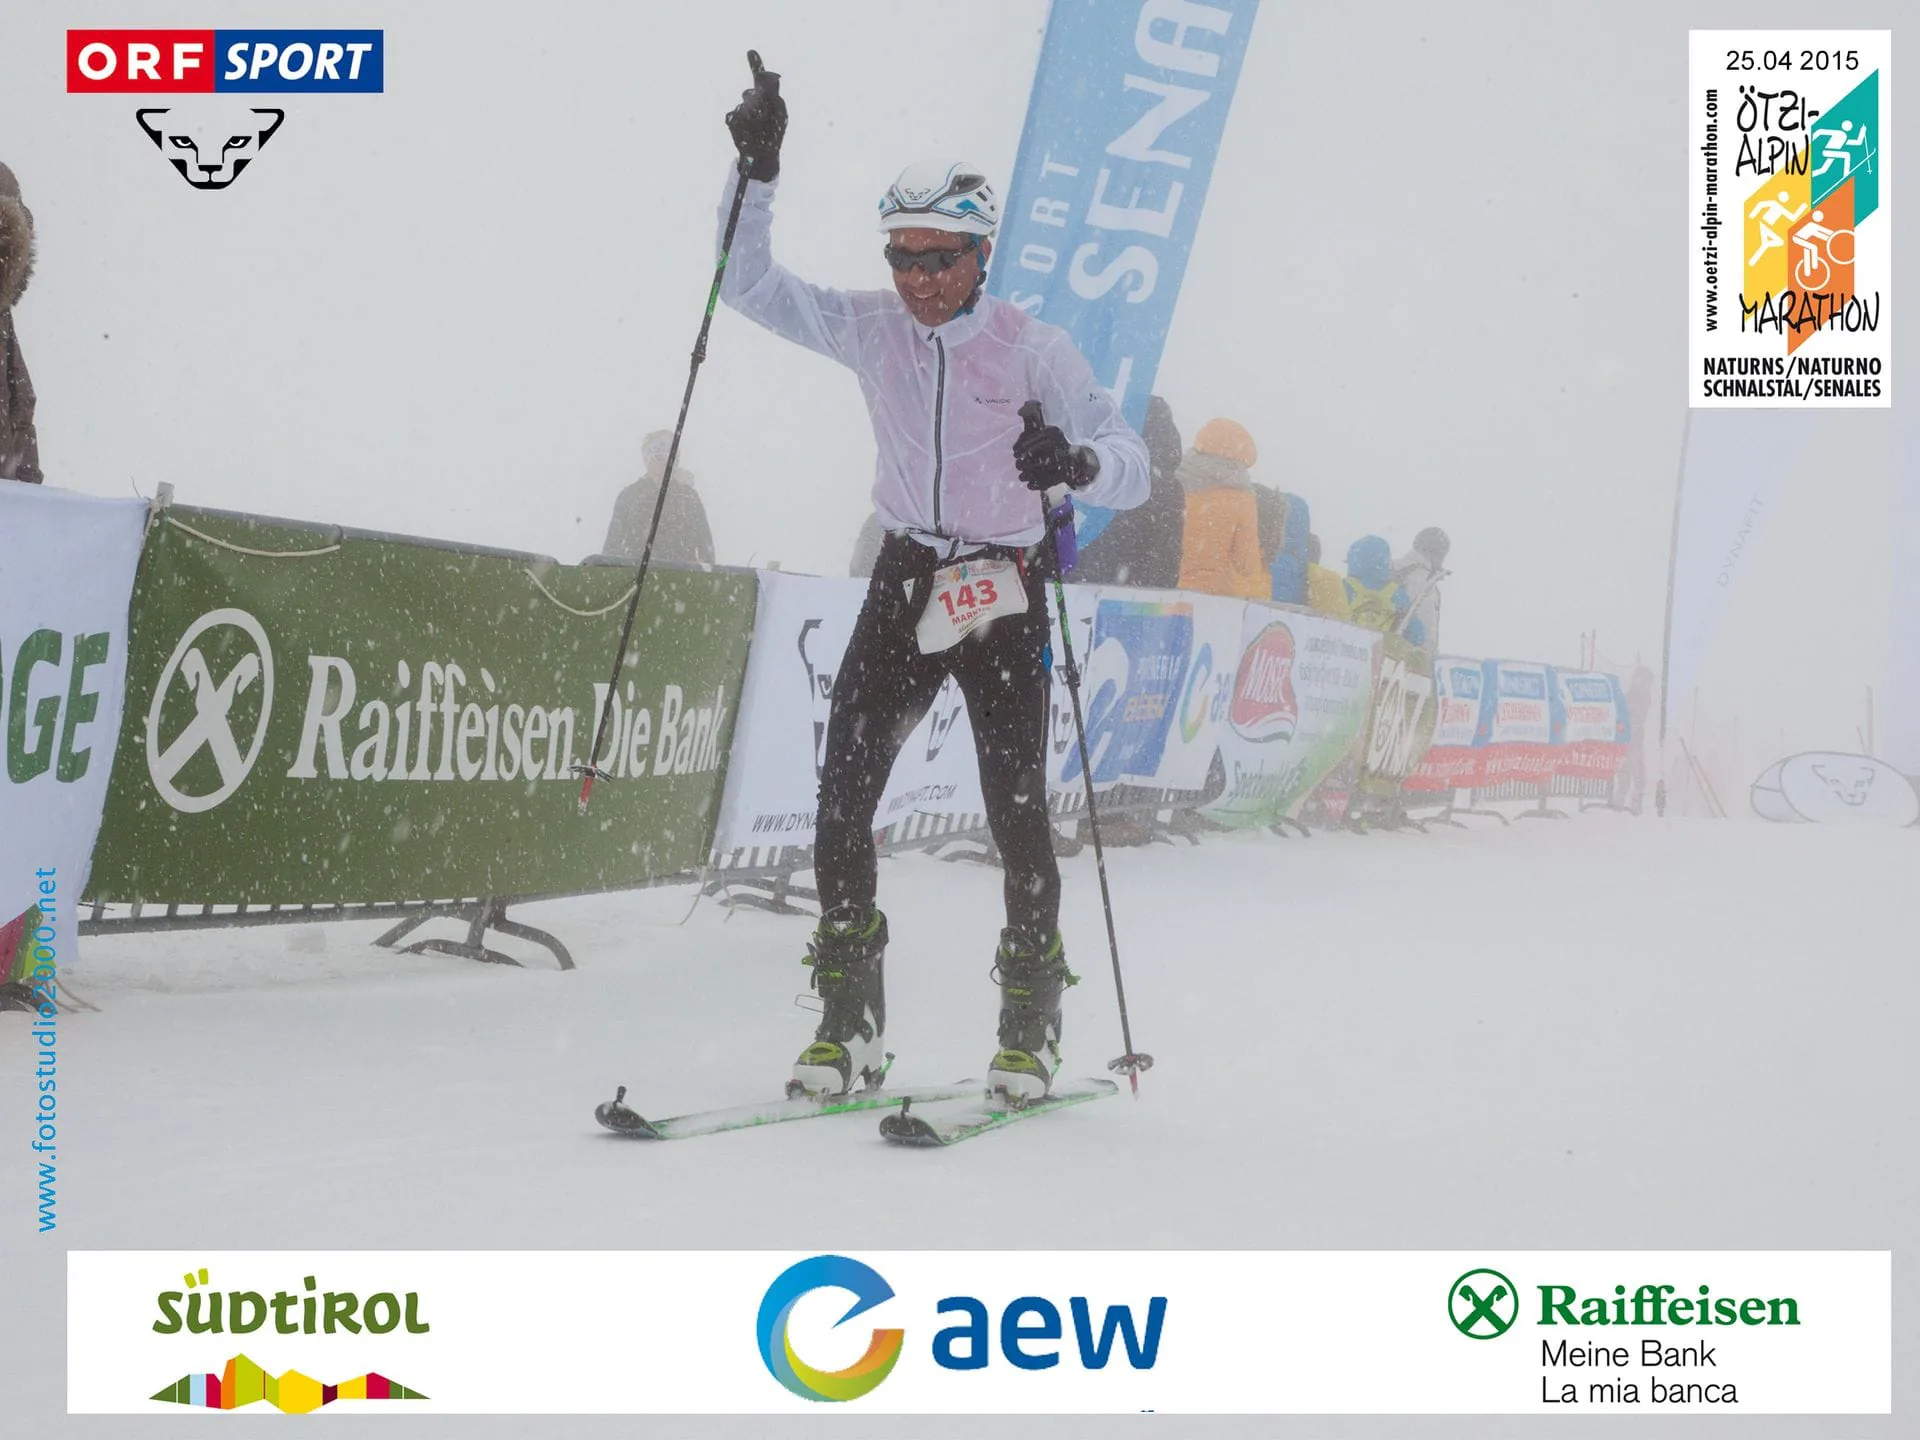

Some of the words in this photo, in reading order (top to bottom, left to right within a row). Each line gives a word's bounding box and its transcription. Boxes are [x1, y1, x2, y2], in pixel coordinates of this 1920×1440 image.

[1715, 493, 1765, 587] DYNAFIT
[938, 579, 998, 616] 143
[0, 628, 110, 784] GE
[590, 681, 651, 779] Die
